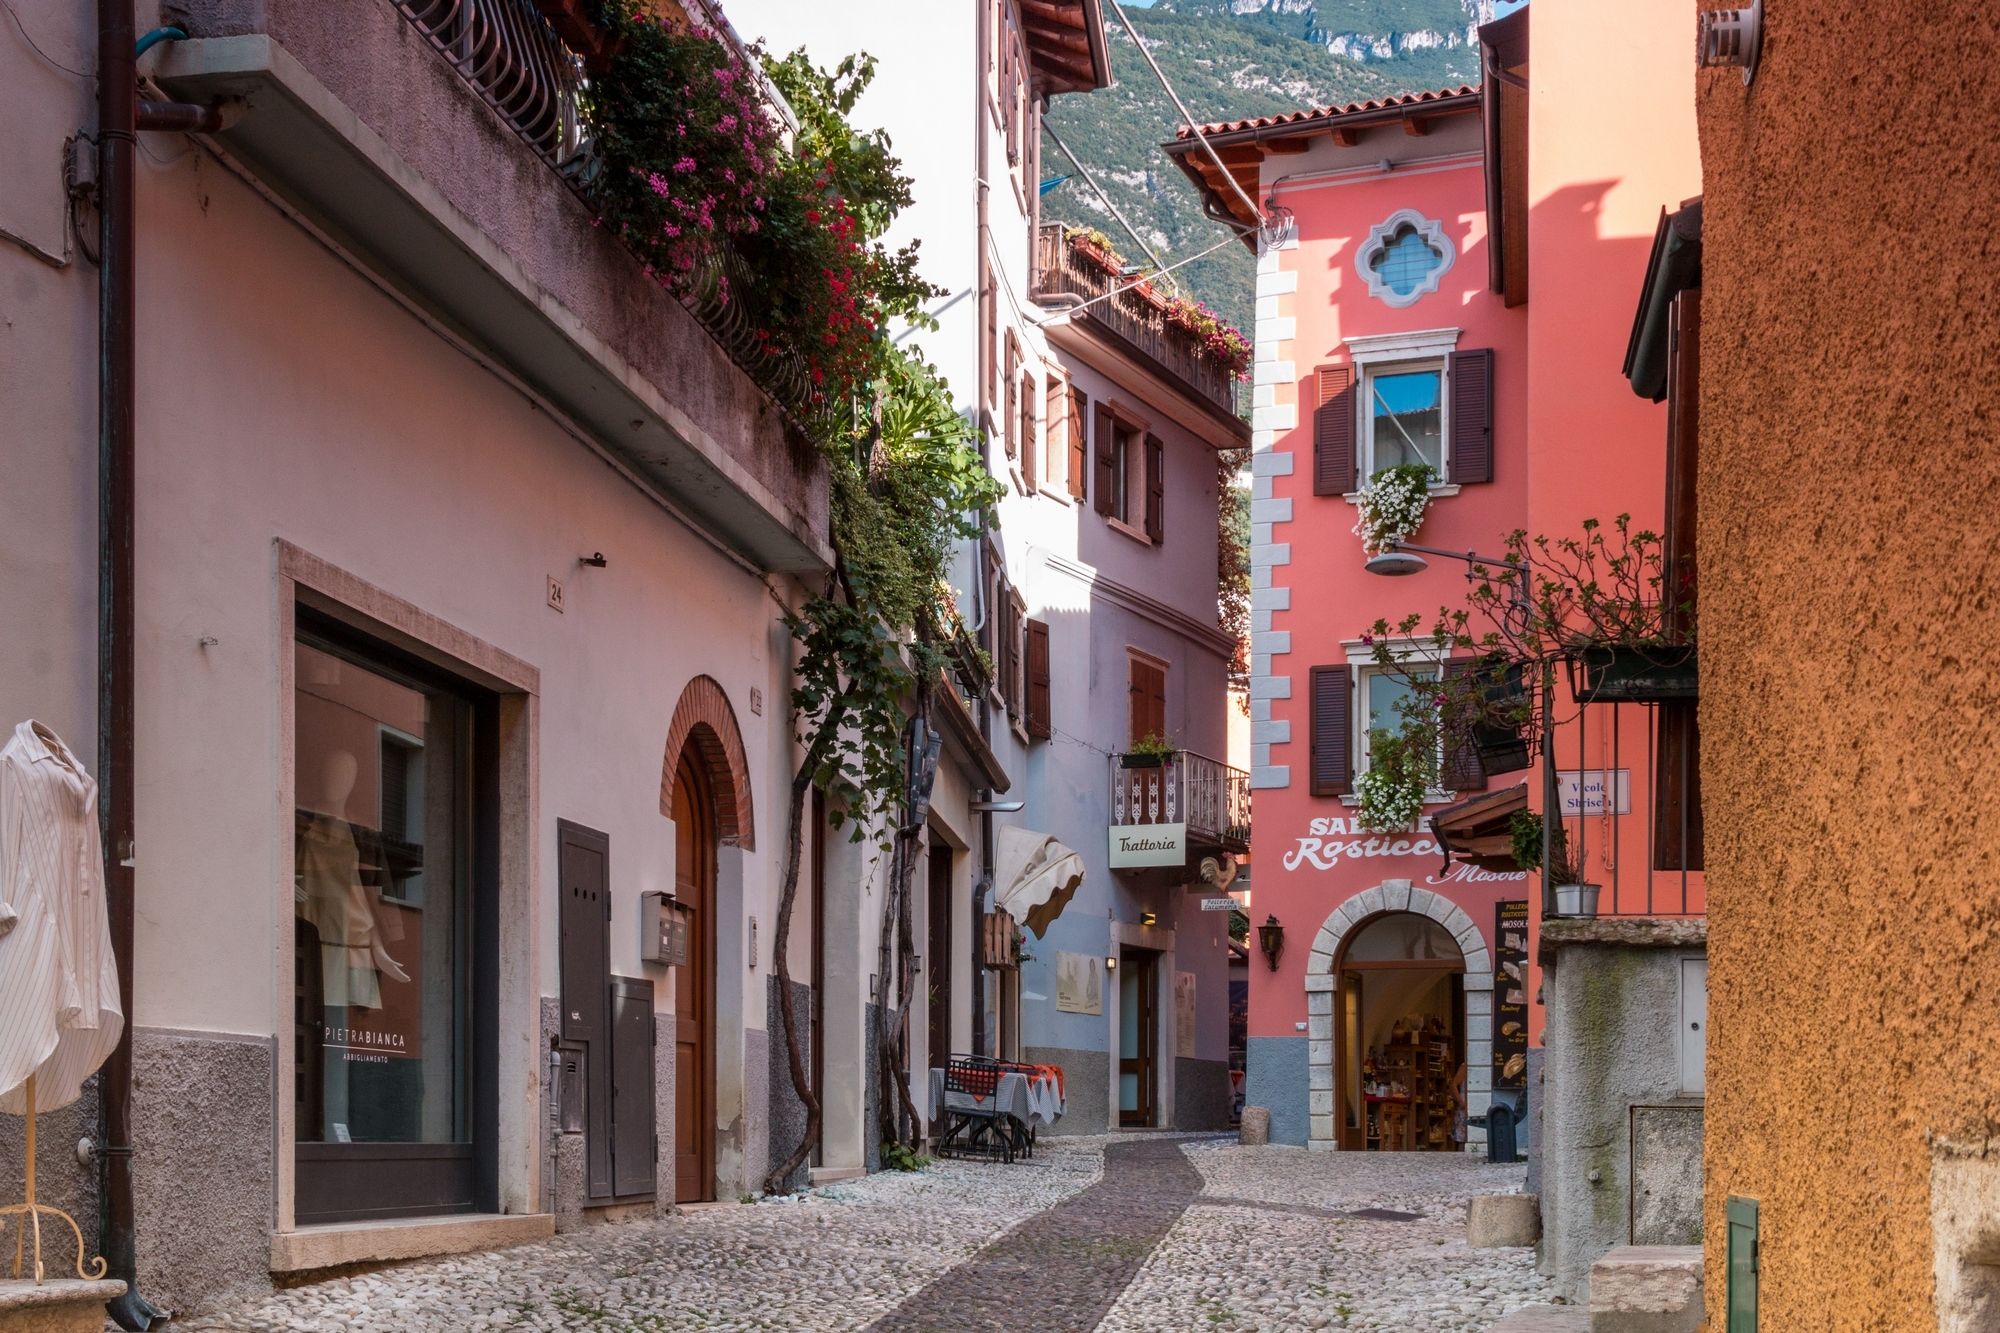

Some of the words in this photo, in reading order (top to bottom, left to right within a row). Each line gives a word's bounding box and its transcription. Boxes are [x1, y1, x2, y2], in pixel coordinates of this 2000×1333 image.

[551, 583, 562, 604] 24
[1572, 782, 1607, 793] Vcol
[1118, 836, 1176, 853] Trattoria
[324, 1026, 405, 1047] PIETRABIANCA
[343, 1053, 388, 1064] ABBIGLIAMENTO
